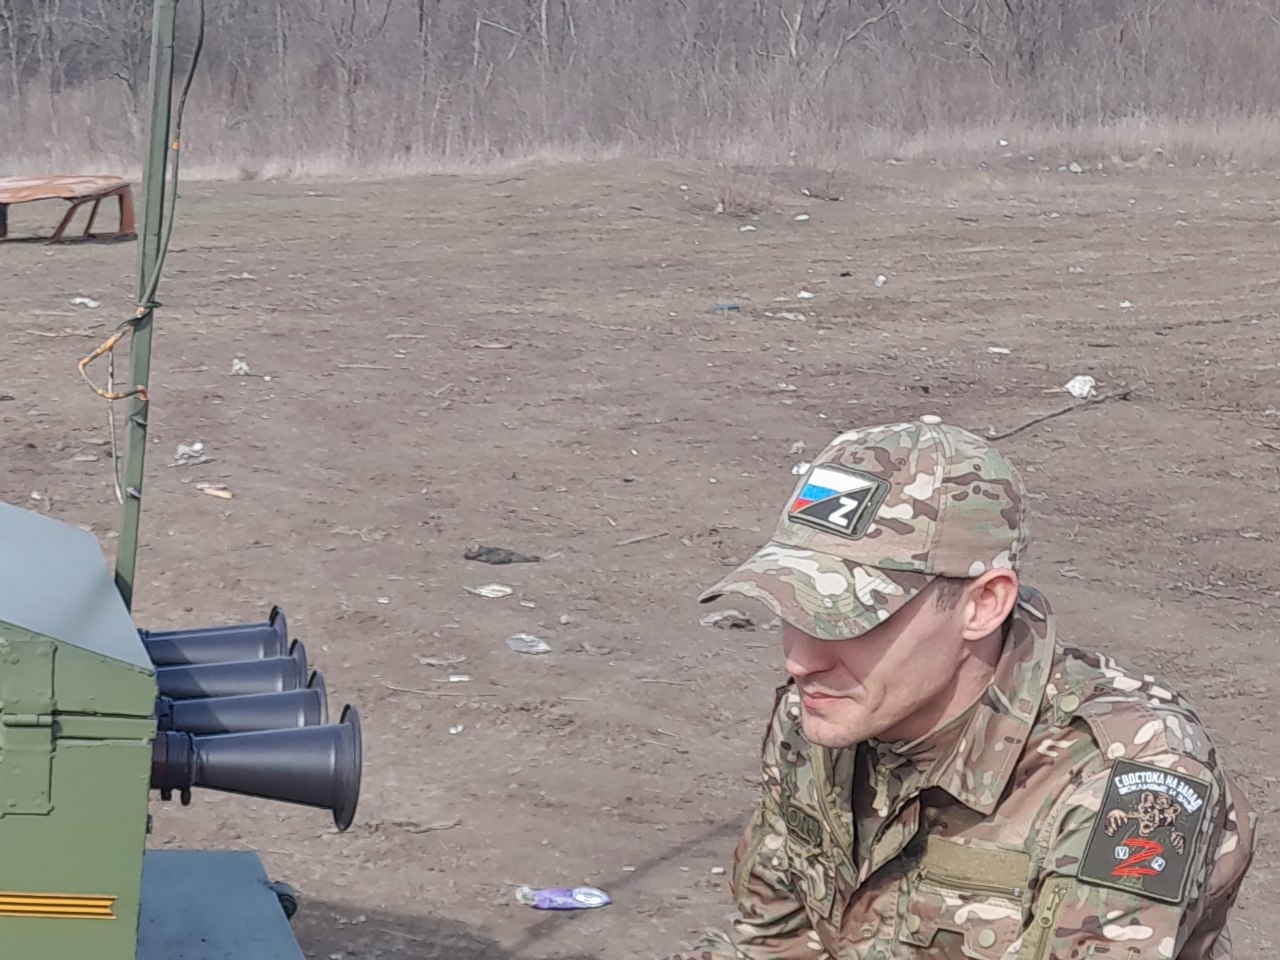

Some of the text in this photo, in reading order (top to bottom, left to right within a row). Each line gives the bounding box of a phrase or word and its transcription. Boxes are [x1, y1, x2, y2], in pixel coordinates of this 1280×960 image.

[828, 496, 858, 527] Z
[1114, 771, 1203, 811] С ВОСТОКА НА ЗАПАД
[1111, 838, 1165, 876] Z
